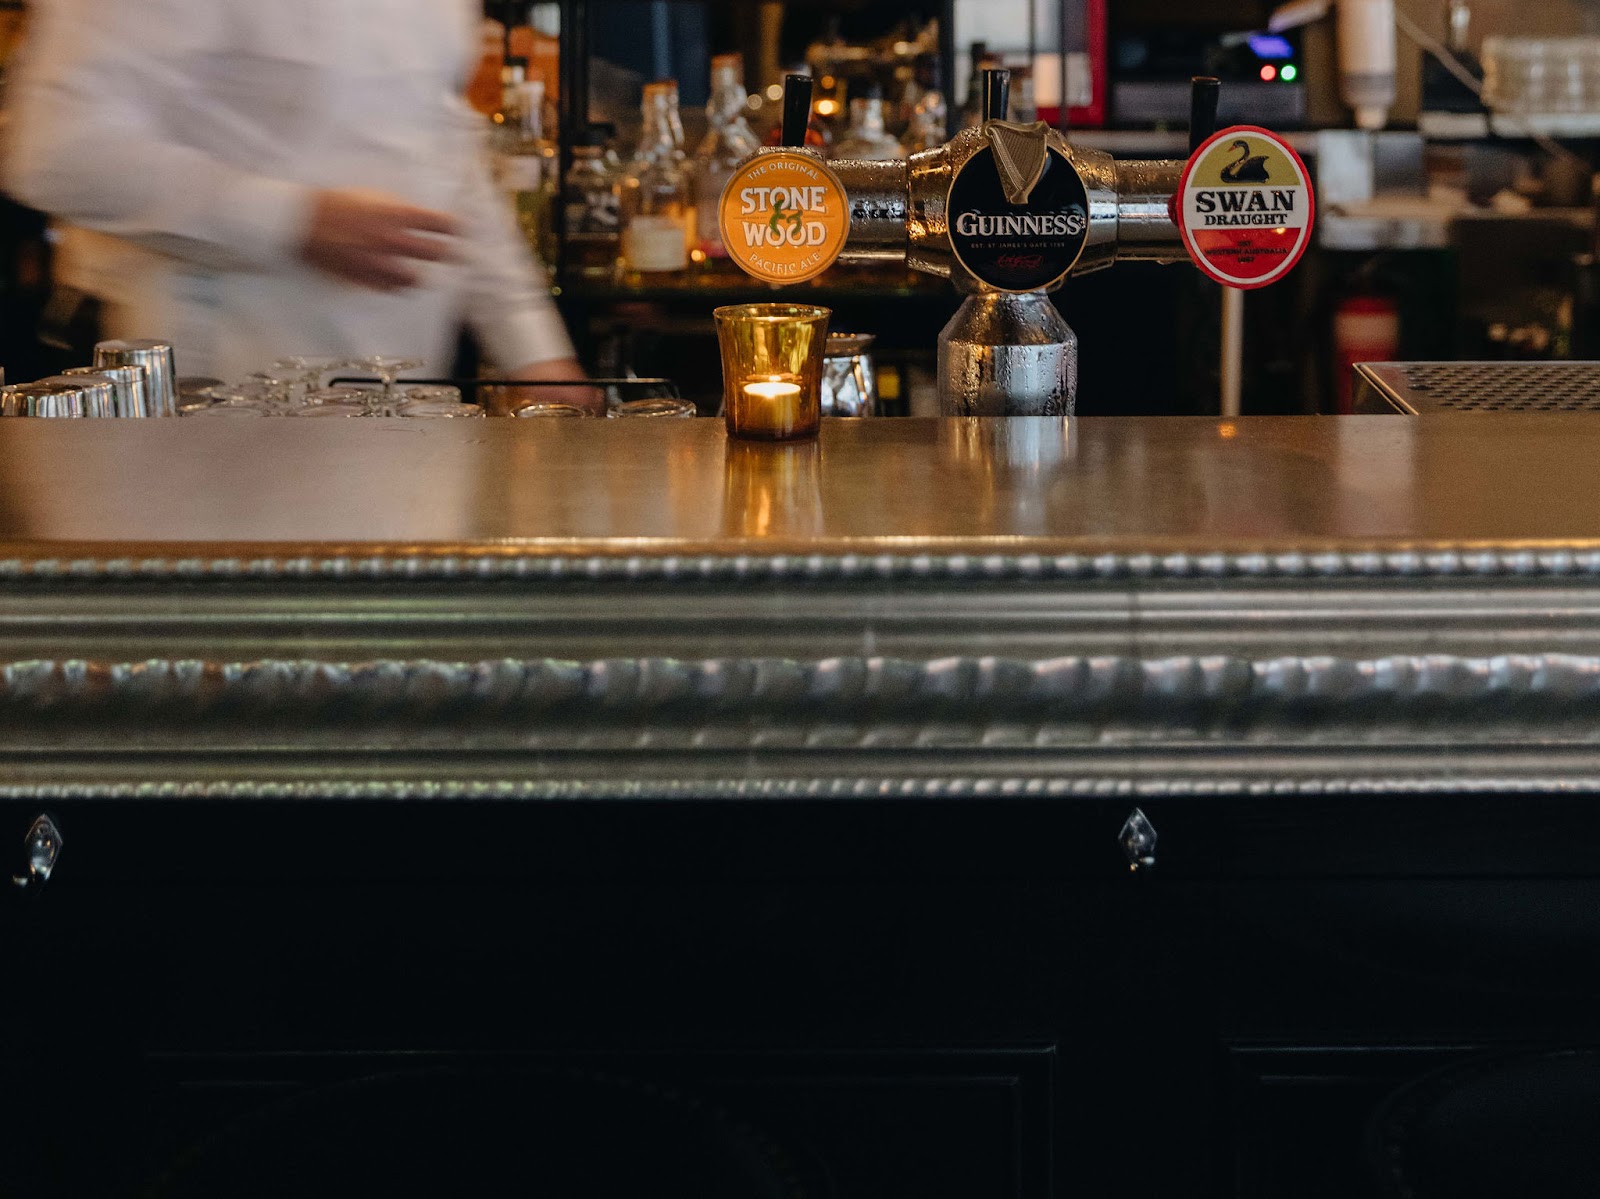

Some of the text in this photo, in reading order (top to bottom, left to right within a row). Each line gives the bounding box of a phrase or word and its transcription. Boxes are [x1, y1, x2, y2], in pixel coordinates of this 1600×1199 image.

[747, 161, 819, 181] THE ORIGINAL
[740, 186, 826, 215] STONE
[1195, 189, 1296, 213] SWAN
[769, 199, 803, 236] &
[956, 212, 1081, 236] GUINNESS
[1204, 213, 1288, 226] DRAUGHT
[742, 221, 826, 247] WOOD
[749, 252, 821, 275] PACIFIC ALE
